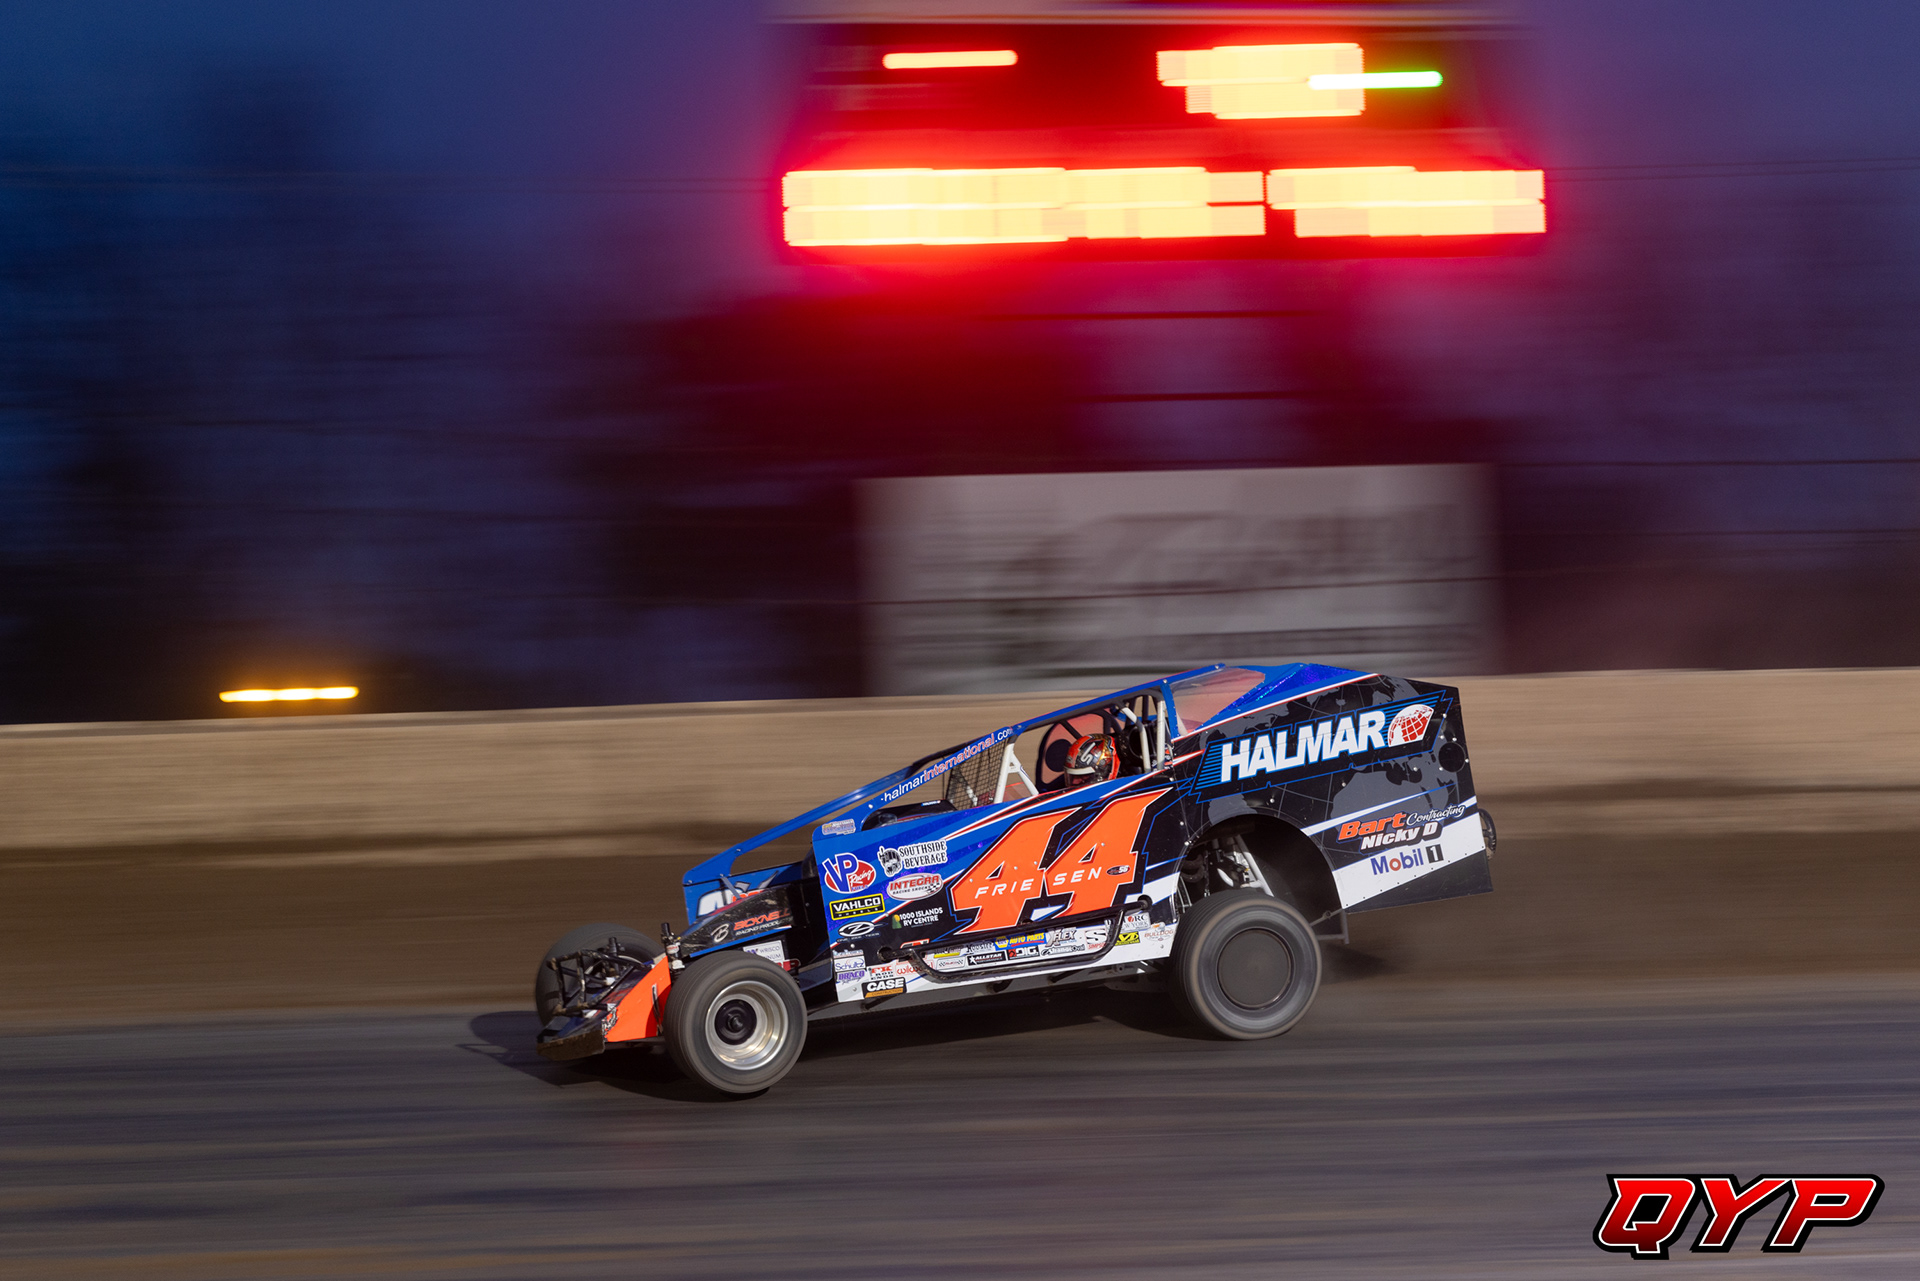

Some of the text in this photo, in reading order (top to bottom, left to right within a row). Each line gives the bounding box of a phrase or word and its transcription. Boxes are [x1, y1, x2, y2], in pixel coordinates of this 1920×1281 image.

[1220, 709, 1387, 783] HALMAR
[1338, 805, 1466, 841] Bart Contracting
[1361, 821, 1439, 850] Nicky D
[899, 841, 946, 857] SOUTHSIDE
[904, 852, 947, 868] BEVERAGE
[951, 787, 1174, 935] 44
[1370, 848, 1424, 876] Mobil
[822, 853, 859, 892] VP
[849, 869, 874, 886] Racing
[890, 875, 939, 891] INTEGRA
[833, 897, 881, 912] VAHLCO
[733, 908, 791, 931] BICKNELL
[899, 907, 943, 920] 1000 ISLANDS
[903, 918, 913, 926] RV
[913, 914, 939, 925] CENTRE
[735, 925, 759, 936] RACING
[1009, 932, 1045, 944] AUTO PARTS
[835, 958, 865, 971] Schultz
[838, 970, 865, 980] DRACO
[866, 978, 904, 992] CASE
